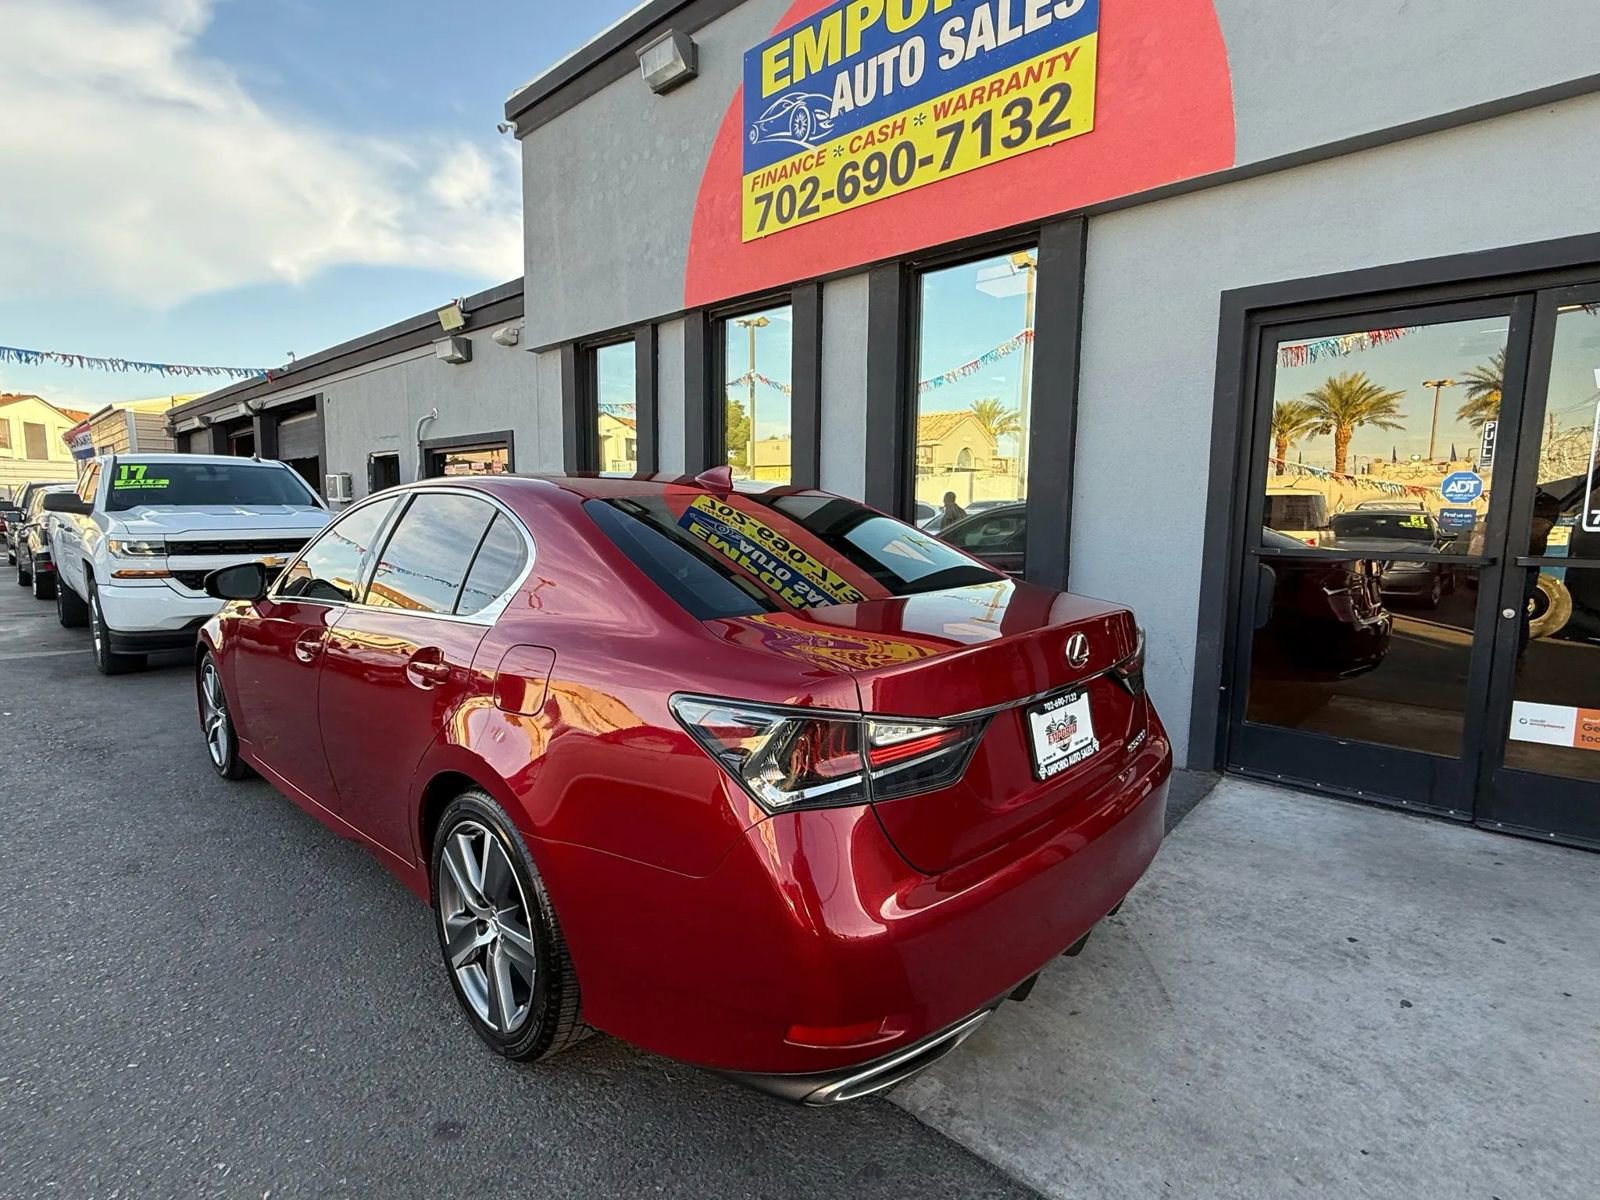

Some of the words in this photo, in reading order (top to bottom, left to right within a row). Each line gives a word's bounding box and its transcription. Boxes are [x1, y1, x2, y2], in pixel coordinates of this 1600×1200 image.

[762, 0, 951, 98] EMPO
[830, 36, 925, 119] AUTO
[751, 148, 827, 192] FINANCE
[848, 117, 907, 154] CASH
[933, 46, 1081, 122] WARRANTY
[754, 82, 1072, 232] 702-690-7132
[120, 465, 147, 480] 17
[1482, 423, 1495, 457] PULL
[1445, 480, 1479, 493] ADT
